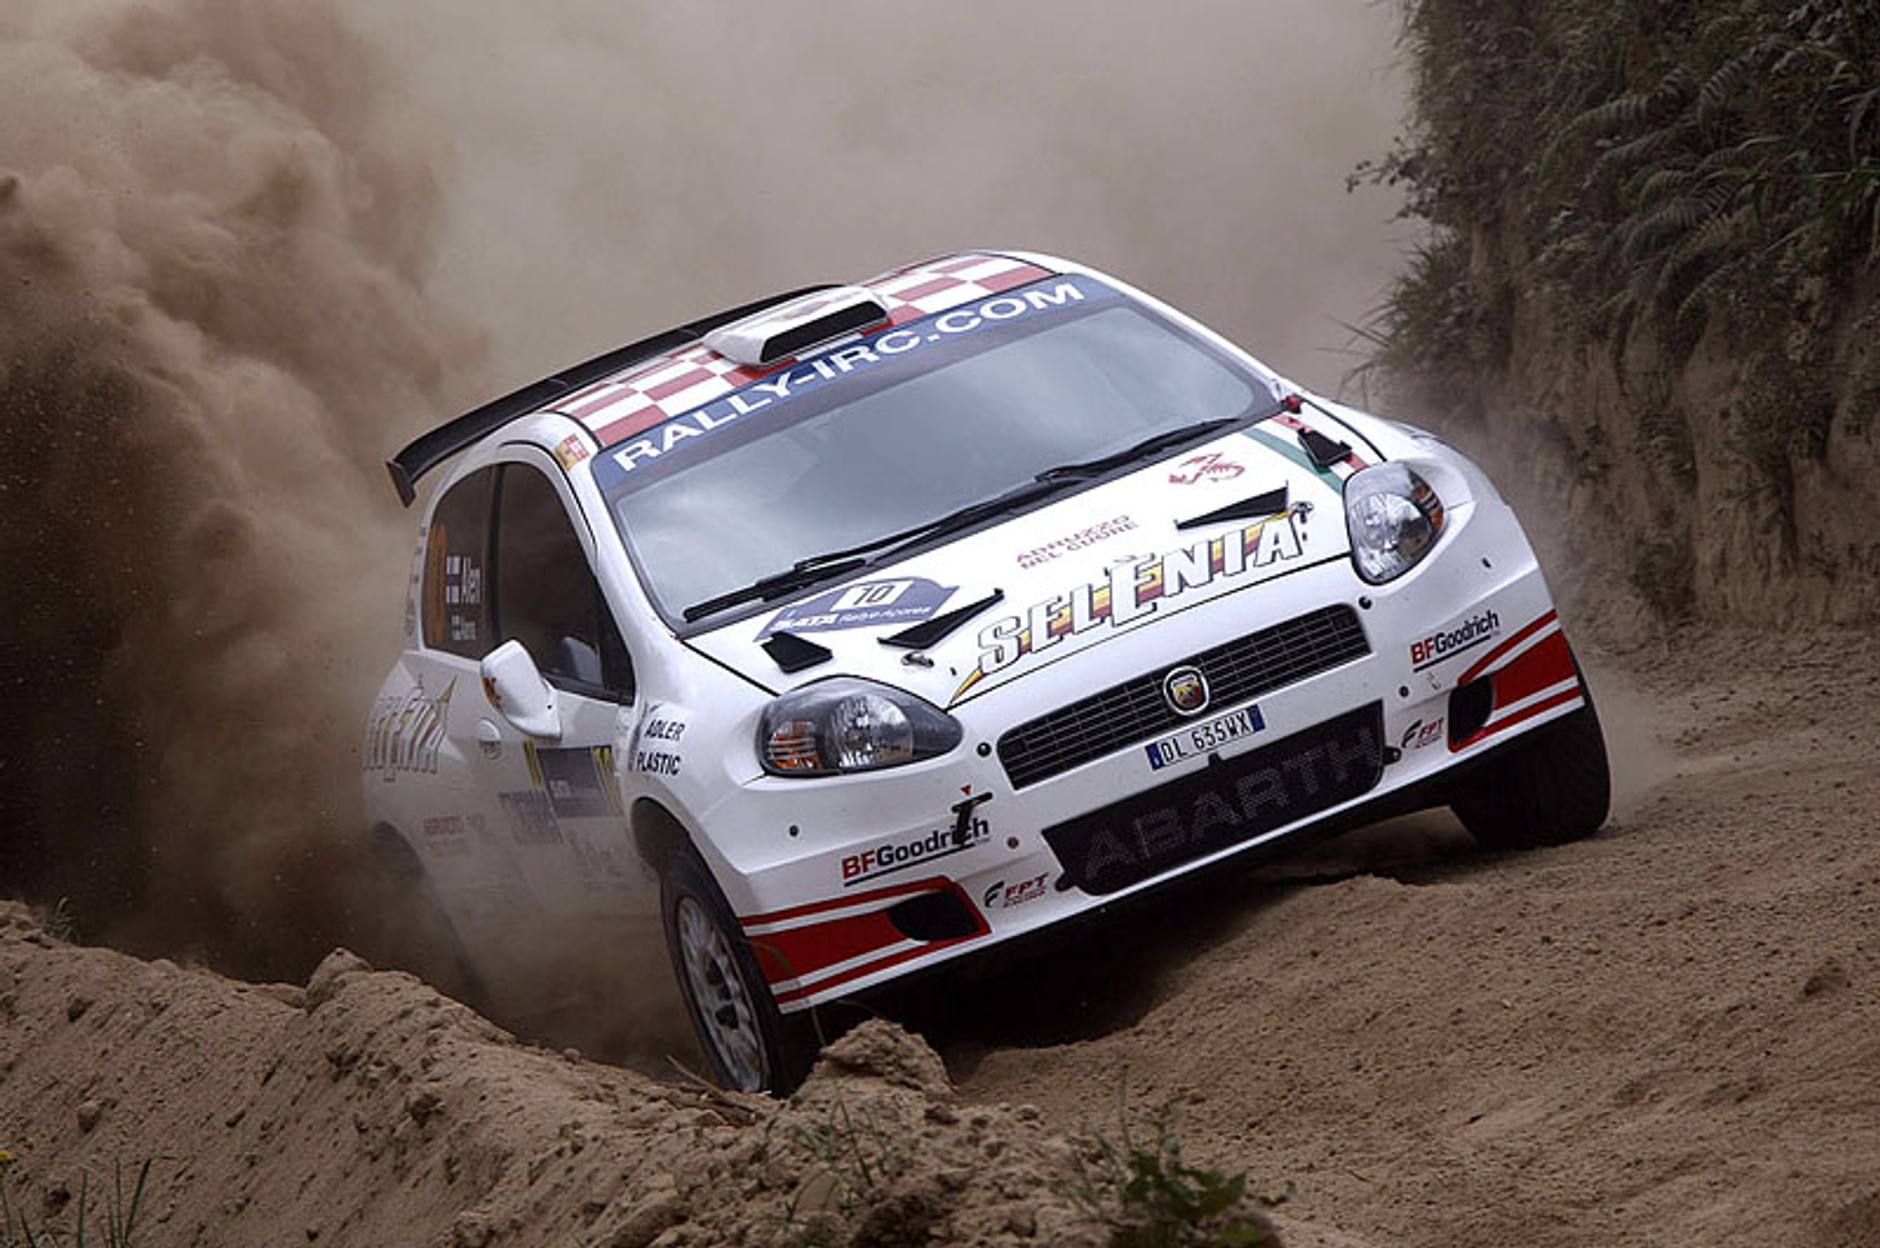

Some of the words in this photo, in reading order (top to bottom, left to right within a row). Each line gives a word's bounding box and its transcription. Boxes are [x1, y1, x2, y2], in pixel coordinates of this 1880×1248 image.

[612, 281, 1086, 472] RALLY-IRC.COM
[853, 584, 897, 606] 10
[977, 510, 1304, 676] SELENIA
[1409, 609, 1500, 665] BFGoodrich
[644, 718, 686, 742] ADLER
[1191, 708, 1252, 751] 635WX
[635, 750, 681, 777] PLASTIC
[1084, 724, 1383, 881] ABARTH
